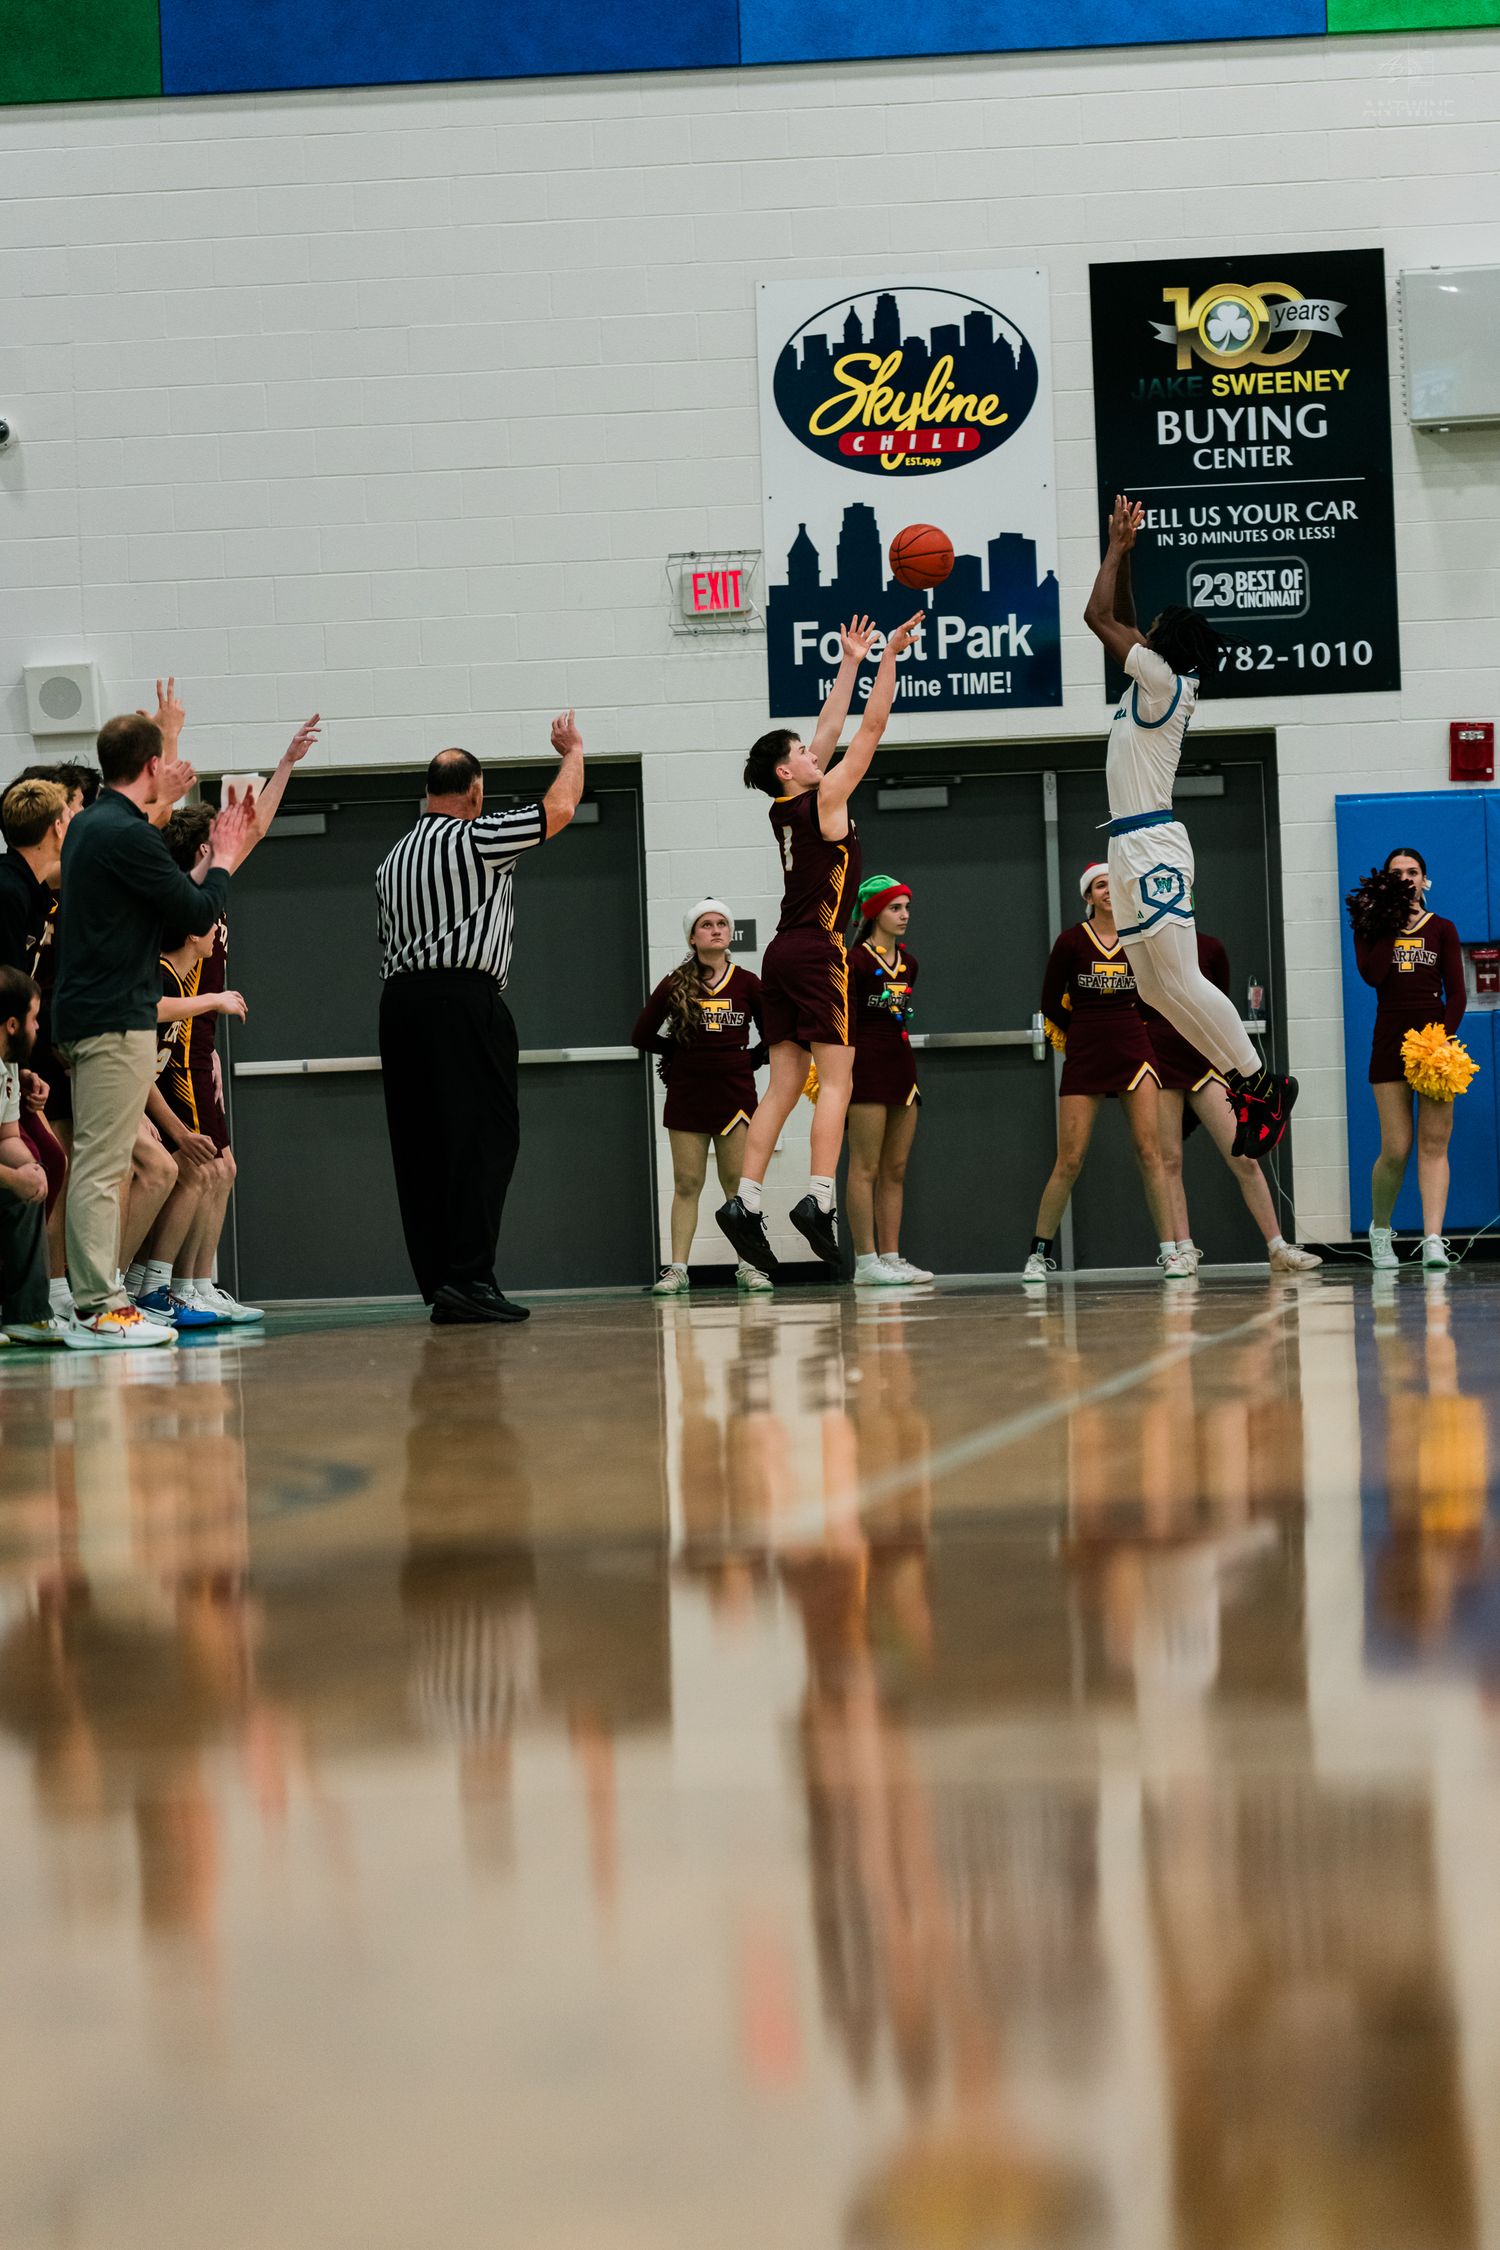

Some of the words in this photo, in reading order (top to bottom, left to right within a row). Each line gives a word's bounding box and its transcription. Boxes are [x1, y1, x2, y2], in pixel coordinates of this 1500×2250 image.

[1163, 282, 1312, 370] 100
[1274, 303, 1330, 328] years
[1131, 376, 1203, 400] JAKE
[1211, 369, 1351, 397] SWEENEY
[809, 350, 1008, 470] Skyline
[1157, 403, 1328, 446] BUYING
[853, 432, 966, 452] CHILI
[1193, 445, 1293, 471] CENTER
[1189, 506, 1221, 527] US
[1227, 503, 1300, 526] YOUR
[1306, 500, 1359, 522] CAR
[1157, 533, 1174, 547] IN
[1178, 532, 1198, 546] 30
[1201, 528, 1268, 544] MINUTES
[1272, 527, 1296, 541] OR
[1300, 526, 1336, 540] LESS!
[692, 570, 742, 611] EXIT
[1193, 572, 1235, 607] 23
[1235, 569, 1276, 592] BEST
[1280, 568, 1303, 590] OF
[793, 620, 928, 666] Foest
[937, 614, 1034, 660] Park
[858, 674, 942, 703] Syline
[947, 672, 1012, 696] TIME!
[782, 825, 794, 872] 1
[1078, 974, 1137, 989] SPARTANS
